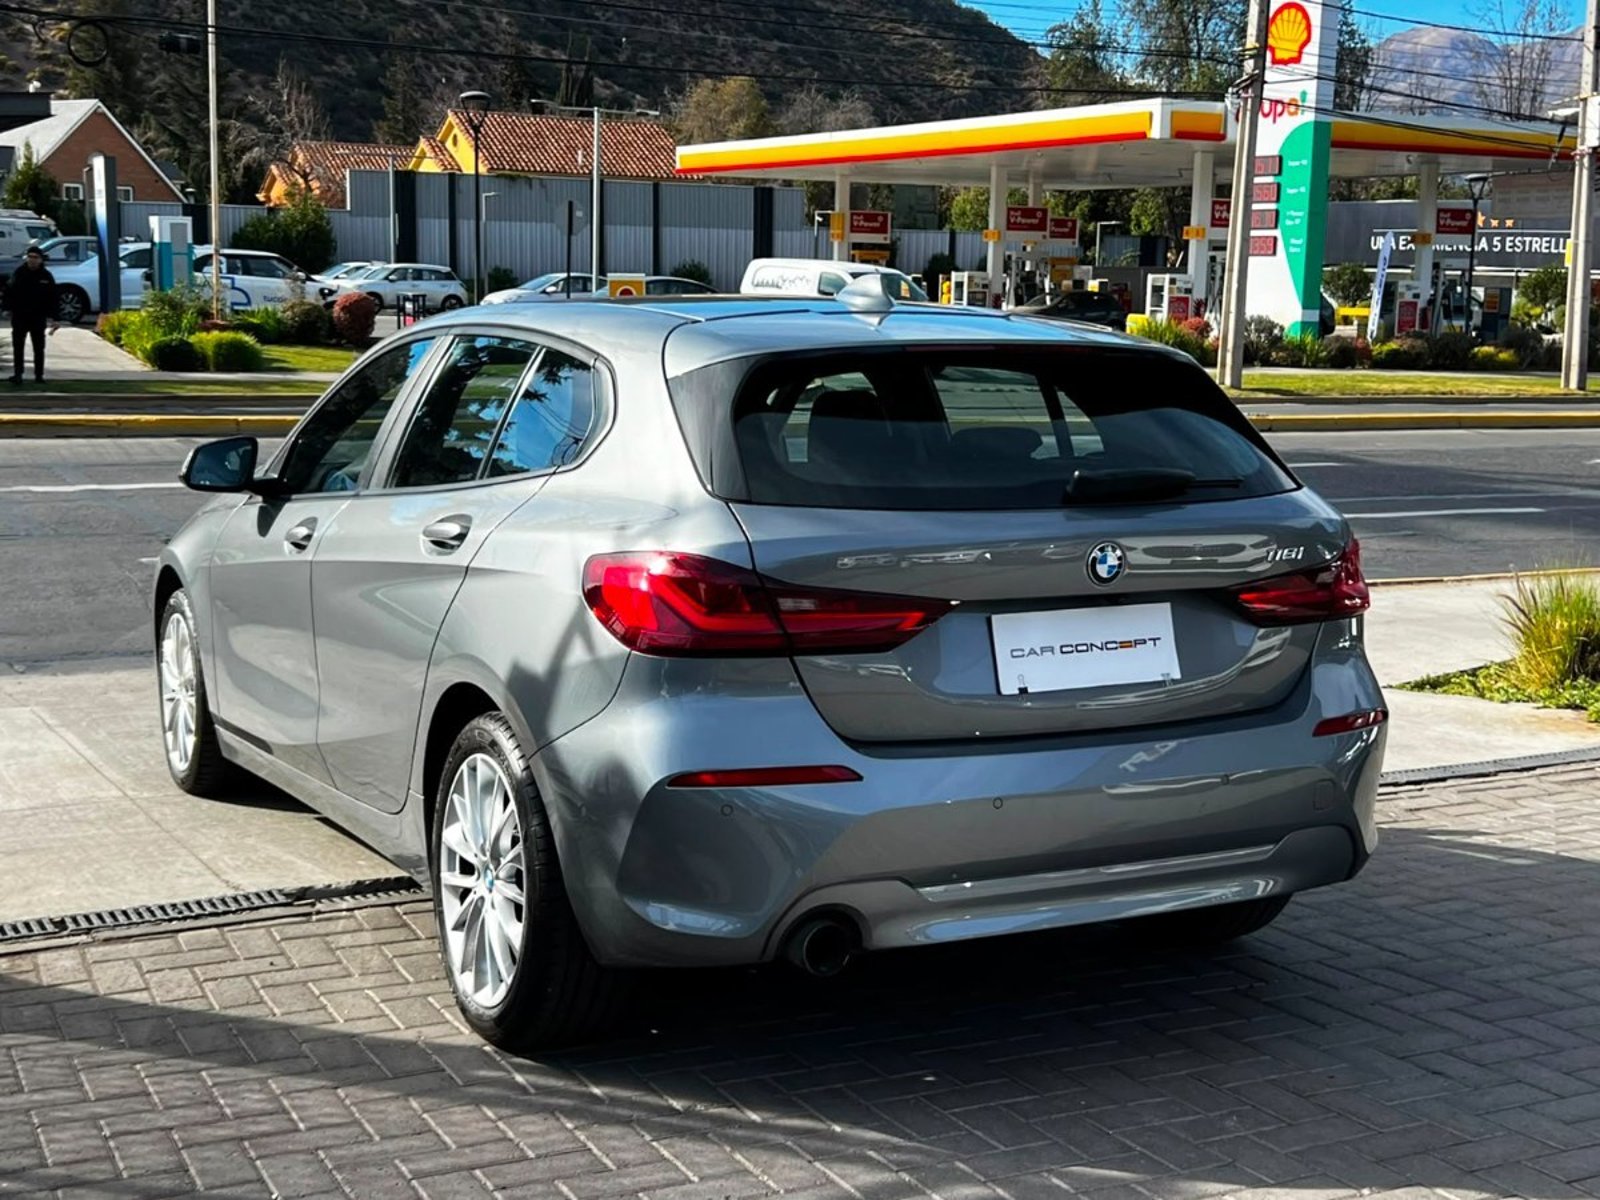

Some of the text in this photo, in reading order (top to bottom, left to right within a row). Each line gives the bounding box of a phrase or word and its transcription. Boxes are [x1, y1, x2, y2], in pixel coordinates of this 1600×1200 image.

[1492, 236, 1501, 252] 5
[1505, 237, 1567, 253] ESTRELL
[1010, 637, 1161, 659] CAR CONCEPT
